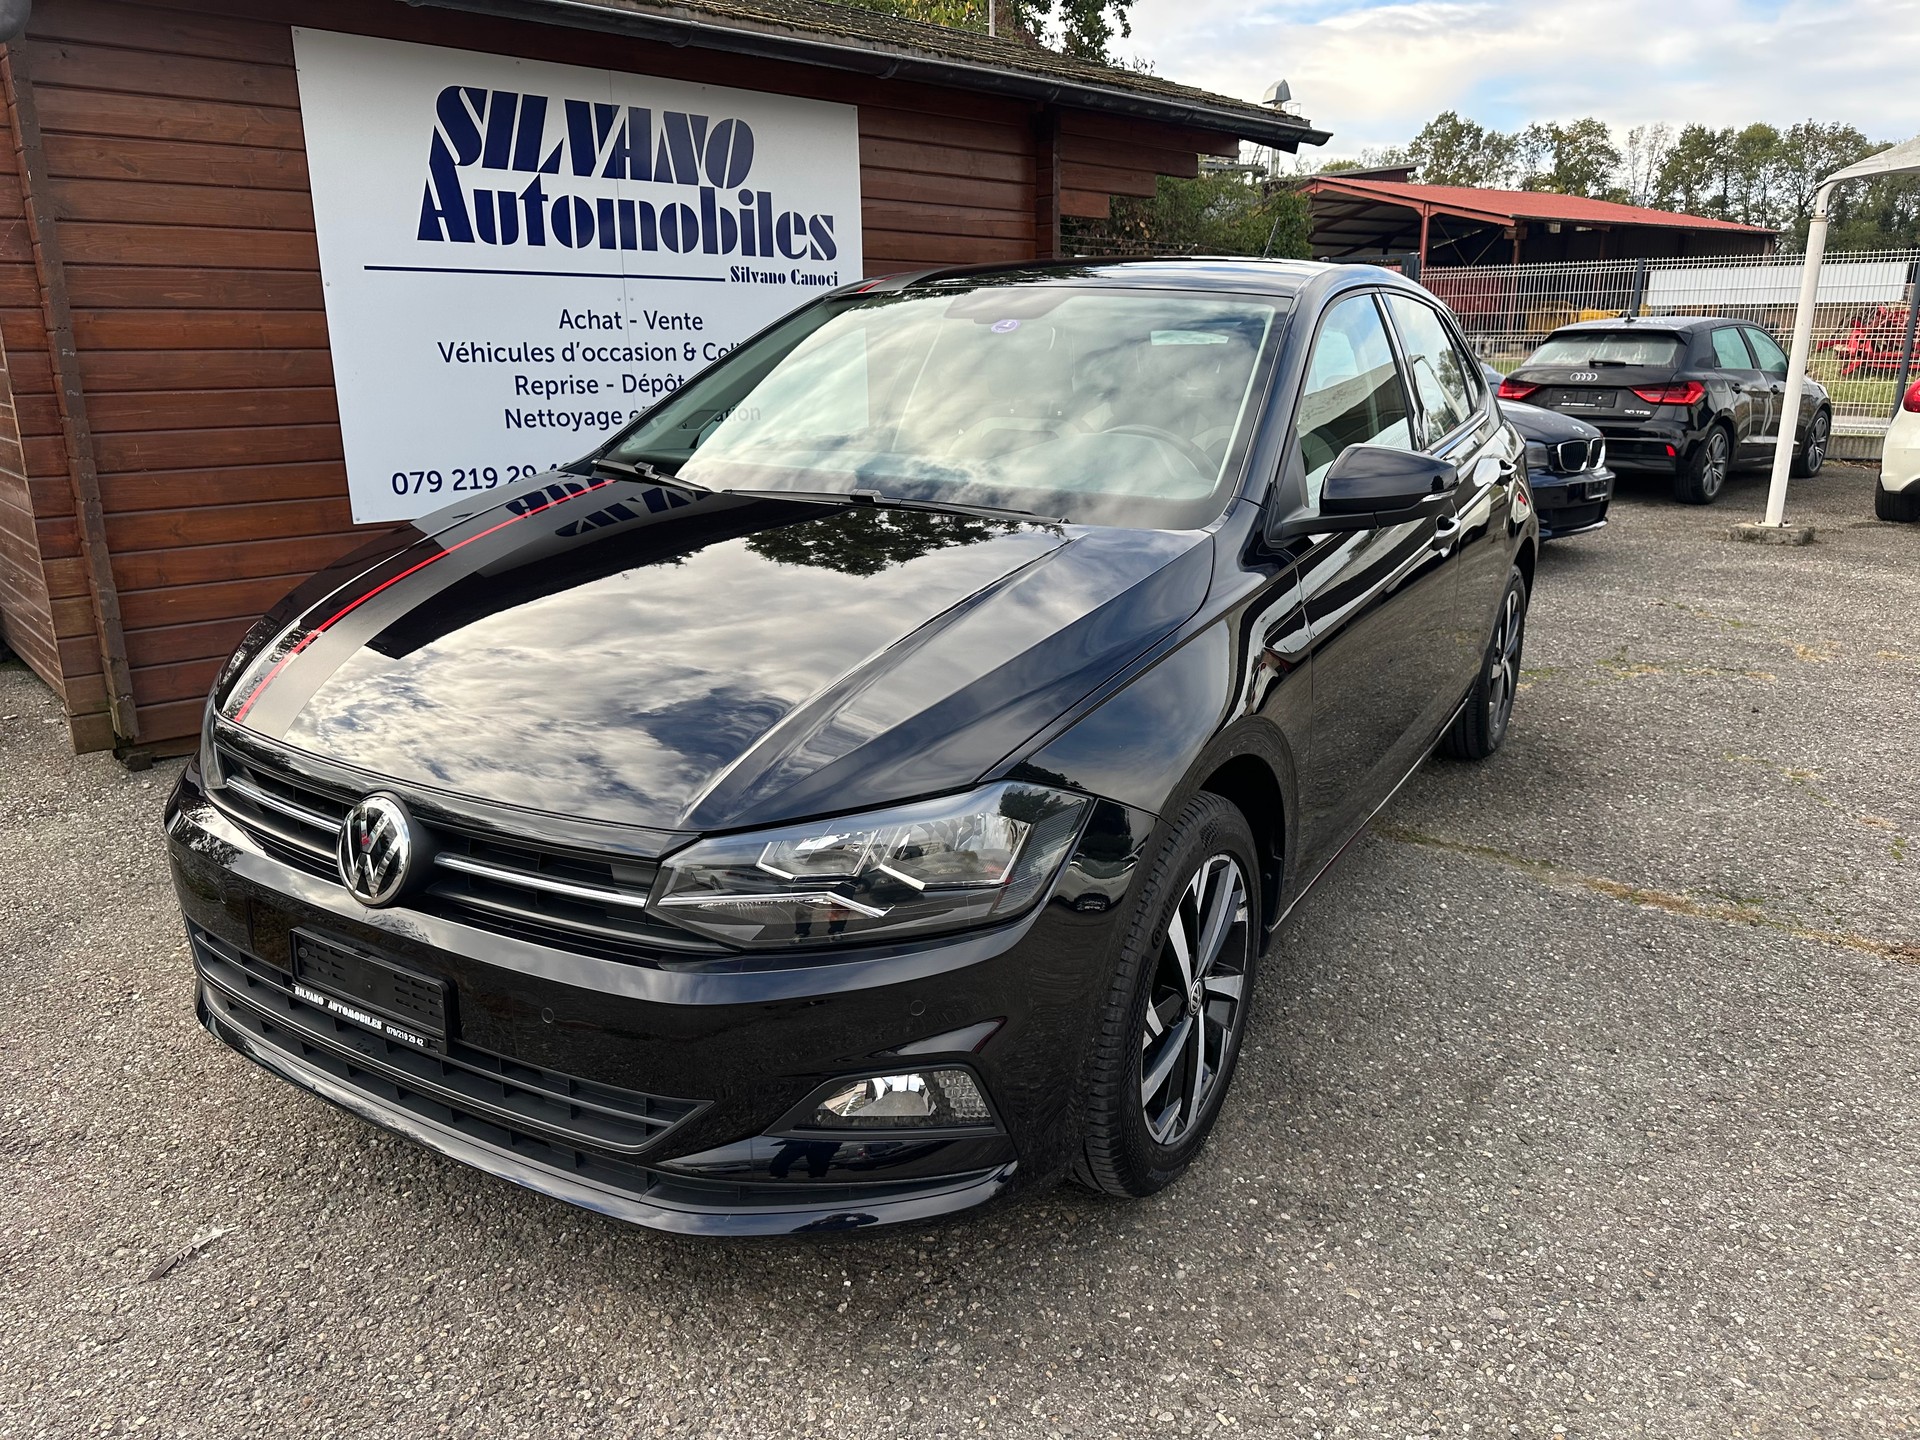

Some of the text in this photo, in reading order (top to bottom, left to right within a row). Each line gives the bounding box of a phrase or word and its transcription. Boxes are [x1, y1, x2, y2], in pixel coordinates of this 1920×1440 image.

[435, 86, 755, 190] SILVANO
[416, 125, 837, 261] Automobiles
[730, 265, 839, 287] Silvano Canoci
[558, 309, 623, 330] Achat
[643, 310, 704, 331] Vente
[437, 341, 555, 363] Véhicules
[683, 342, 697, 362] &
[514, 375, 599, 401] Reprise
[504, 408, 623, 432] Nettoyage
[391, 471, 443, 496] 079
[451, 466, 498, 492] 219
[294, 985, 324, 1006] SILVANO
[327, 1000, 382, 1030] AUTOMOBILES
[416, 1038, 424, 1047] 42
